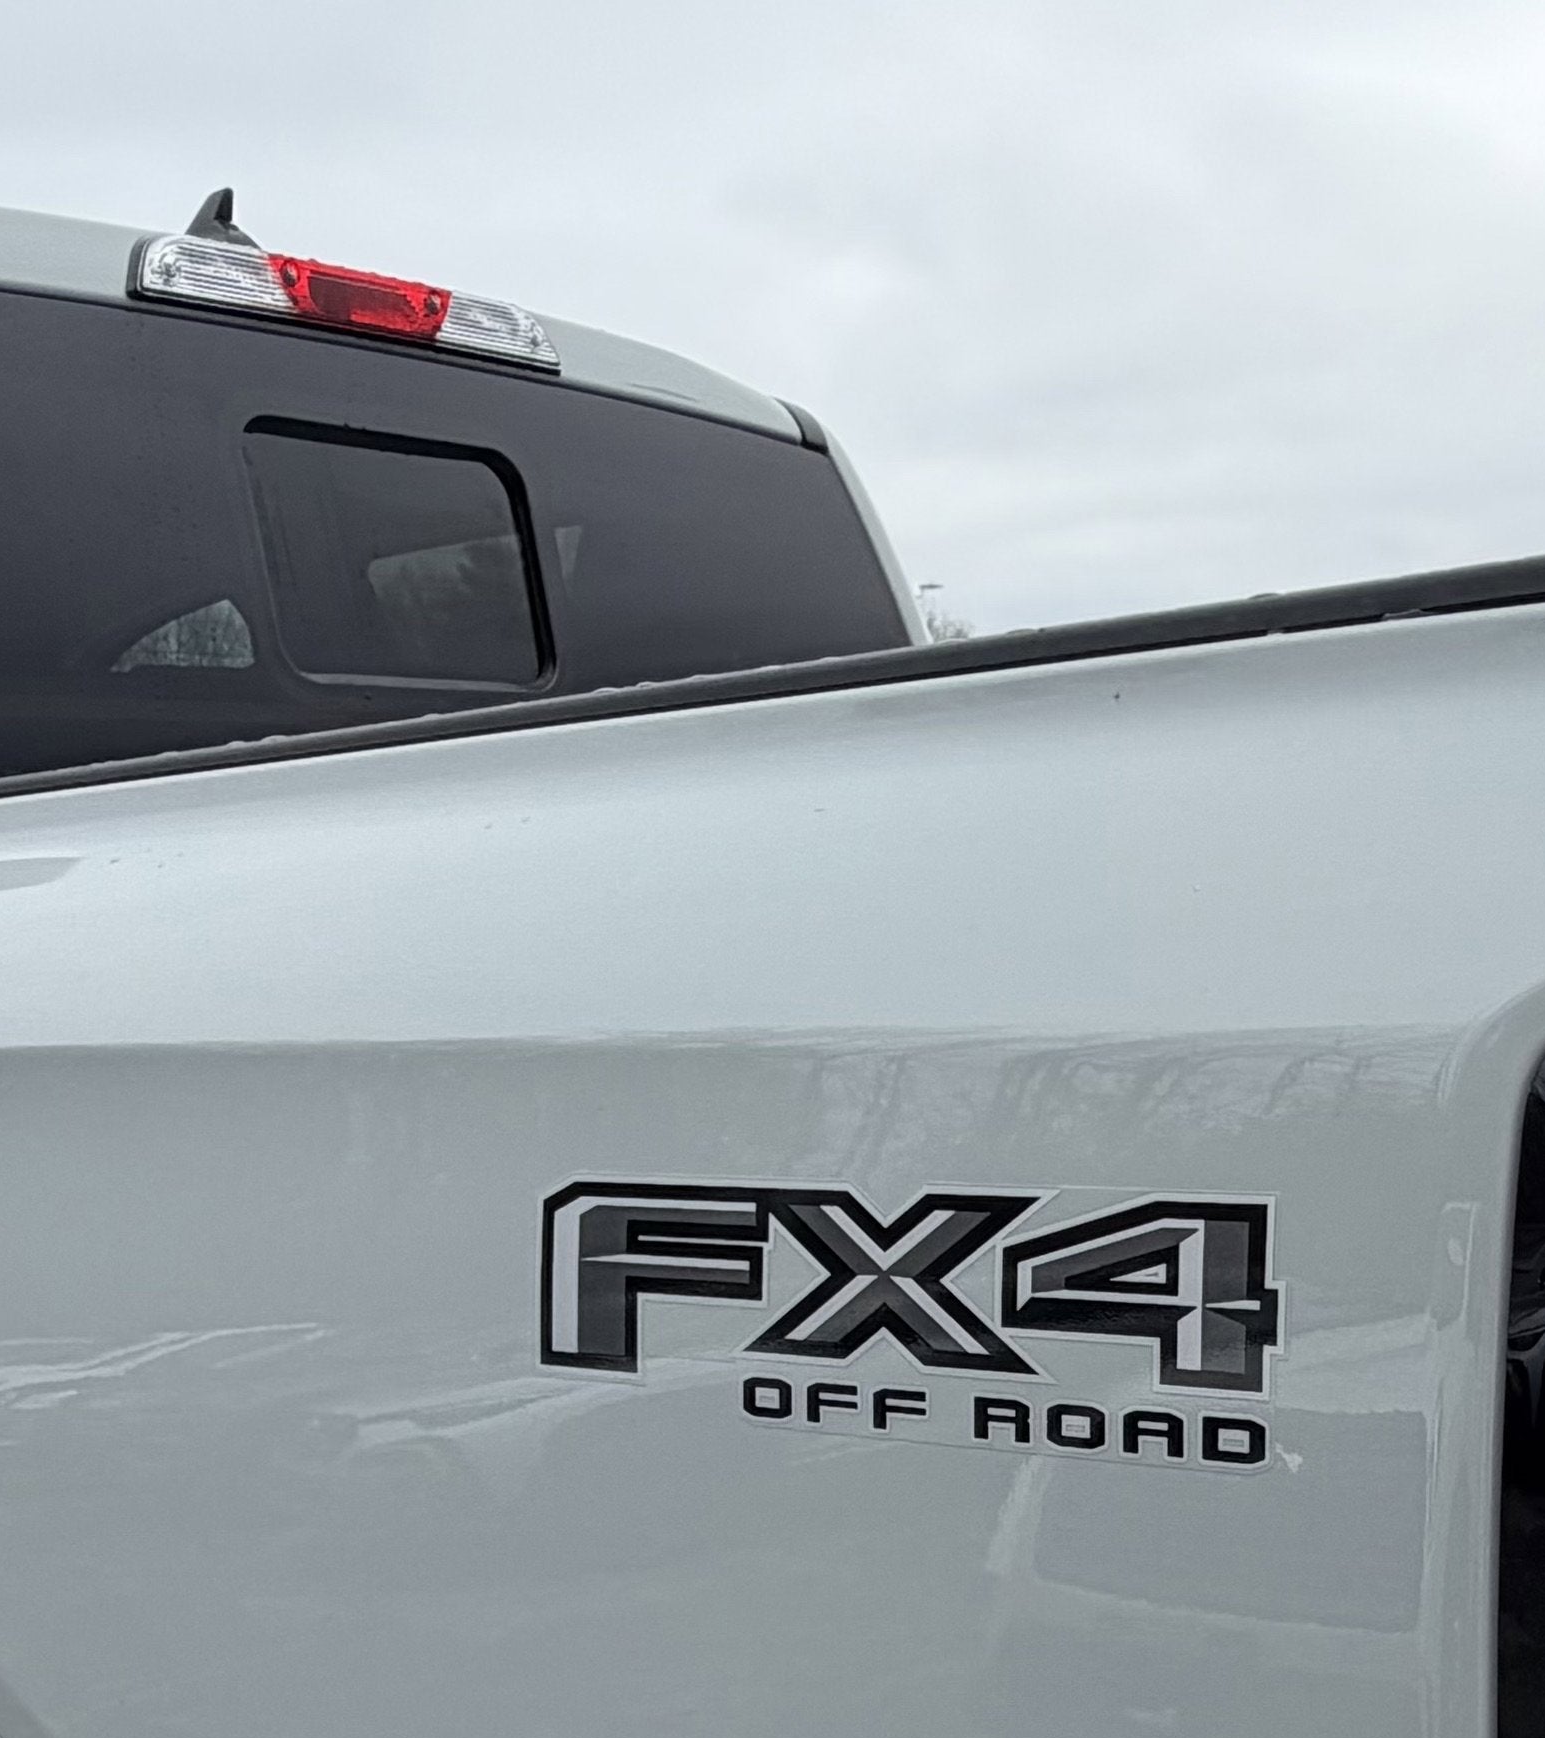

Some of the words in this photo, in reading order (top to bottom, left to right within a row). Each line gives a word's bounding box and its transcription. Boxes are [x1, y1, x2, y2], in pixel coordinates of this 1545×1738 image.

[539, 1179, 1279, 1393] FX4
[742, 1375, 929, 1430] OFF
[973, 1394, 1267, 1464] ROAD
